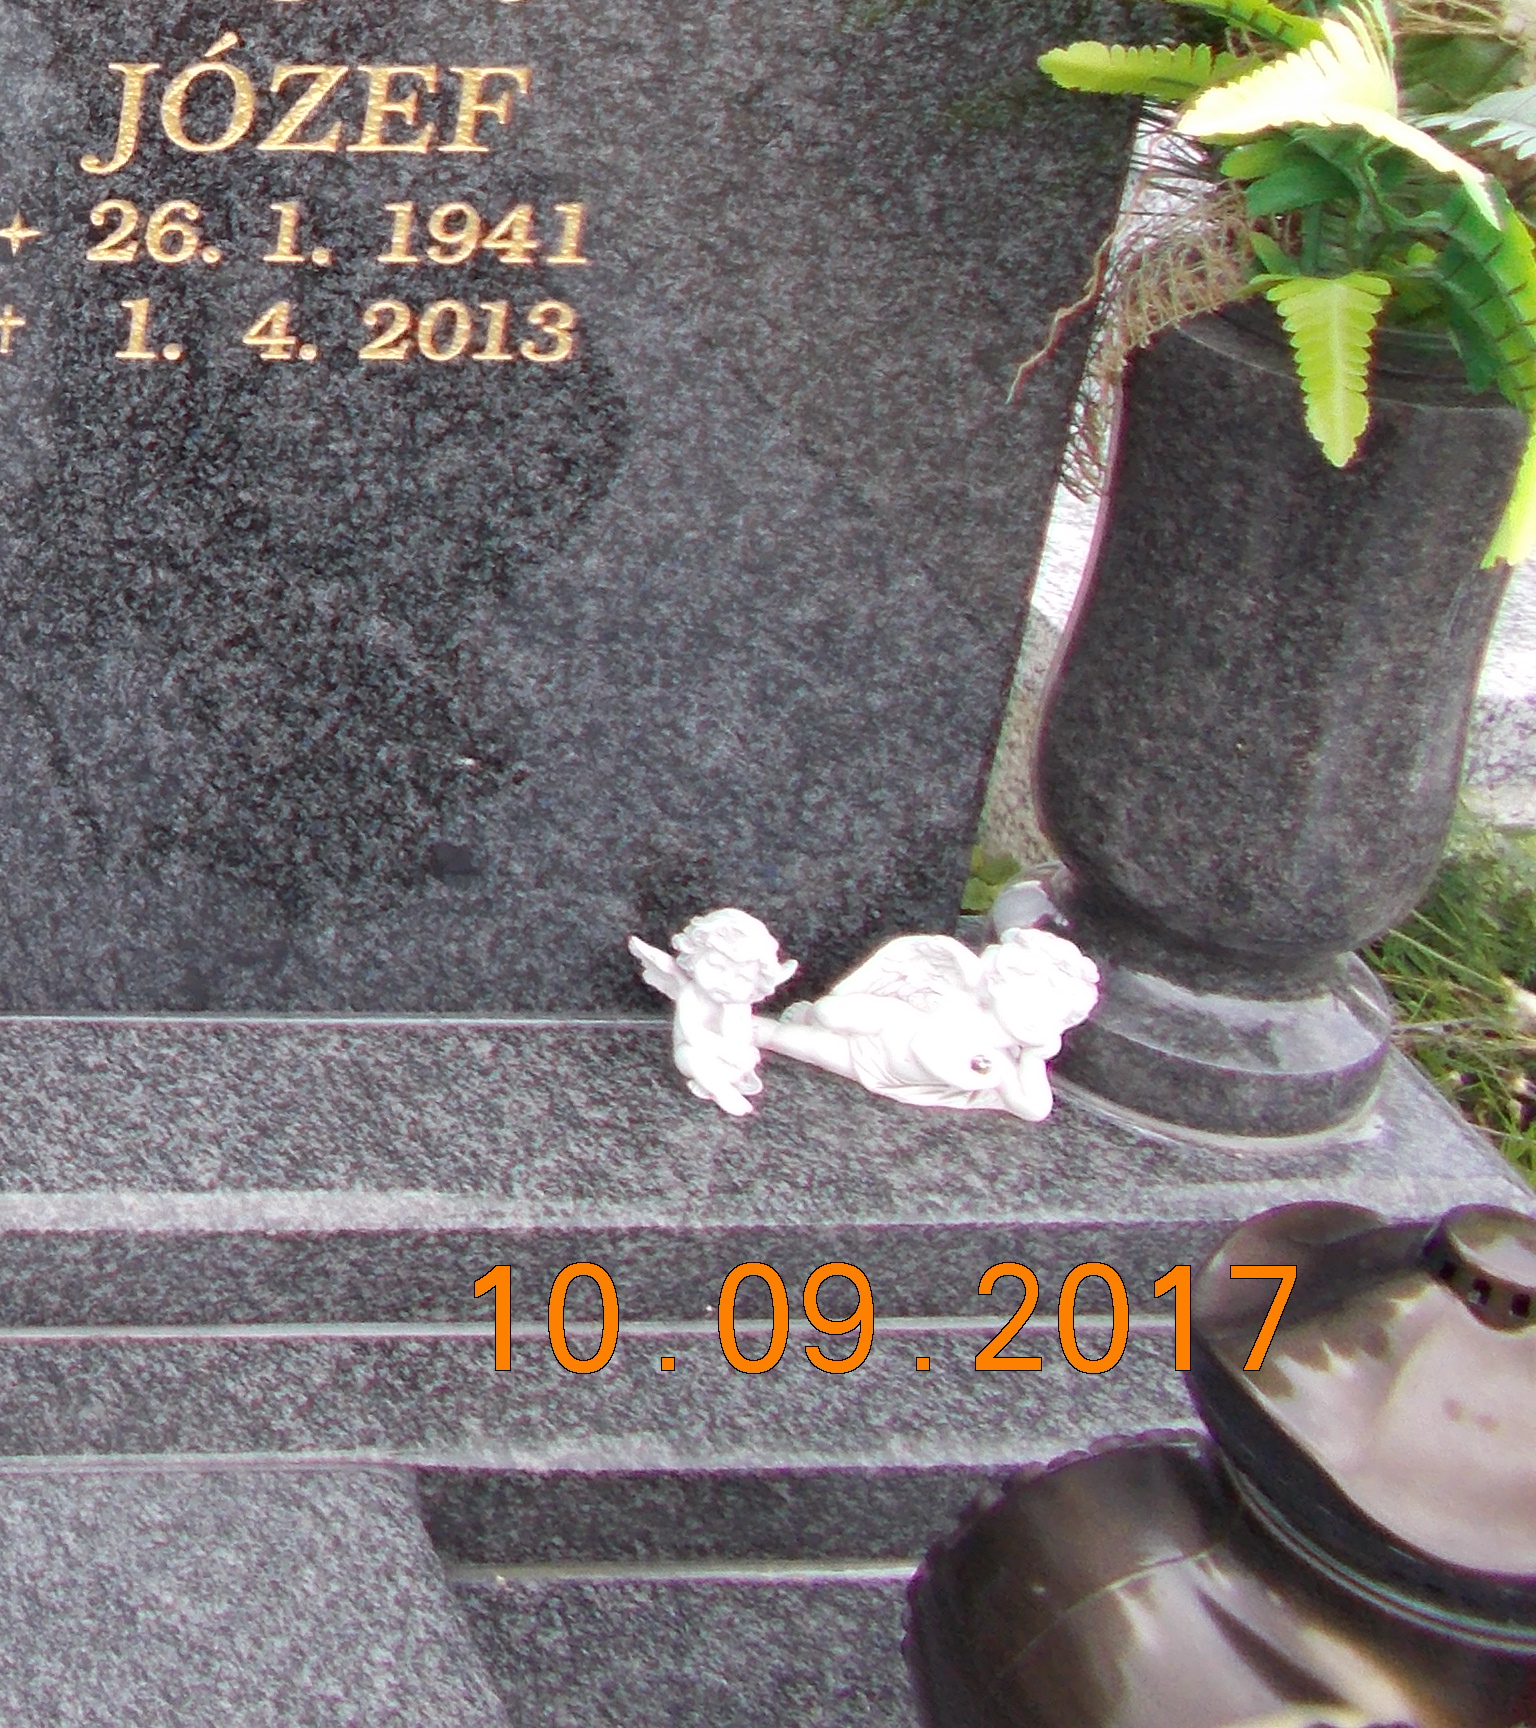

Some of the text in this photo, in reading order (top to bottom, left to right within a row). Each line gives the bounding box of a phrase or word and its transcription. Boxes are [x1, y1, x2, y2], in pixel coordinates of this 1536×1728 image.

[79, 31, 529, 175] JÓZEF
[86, 199, 588, 265] 26. 1. 1941
[114, 297, 577, 363] 1. 4. 2013
